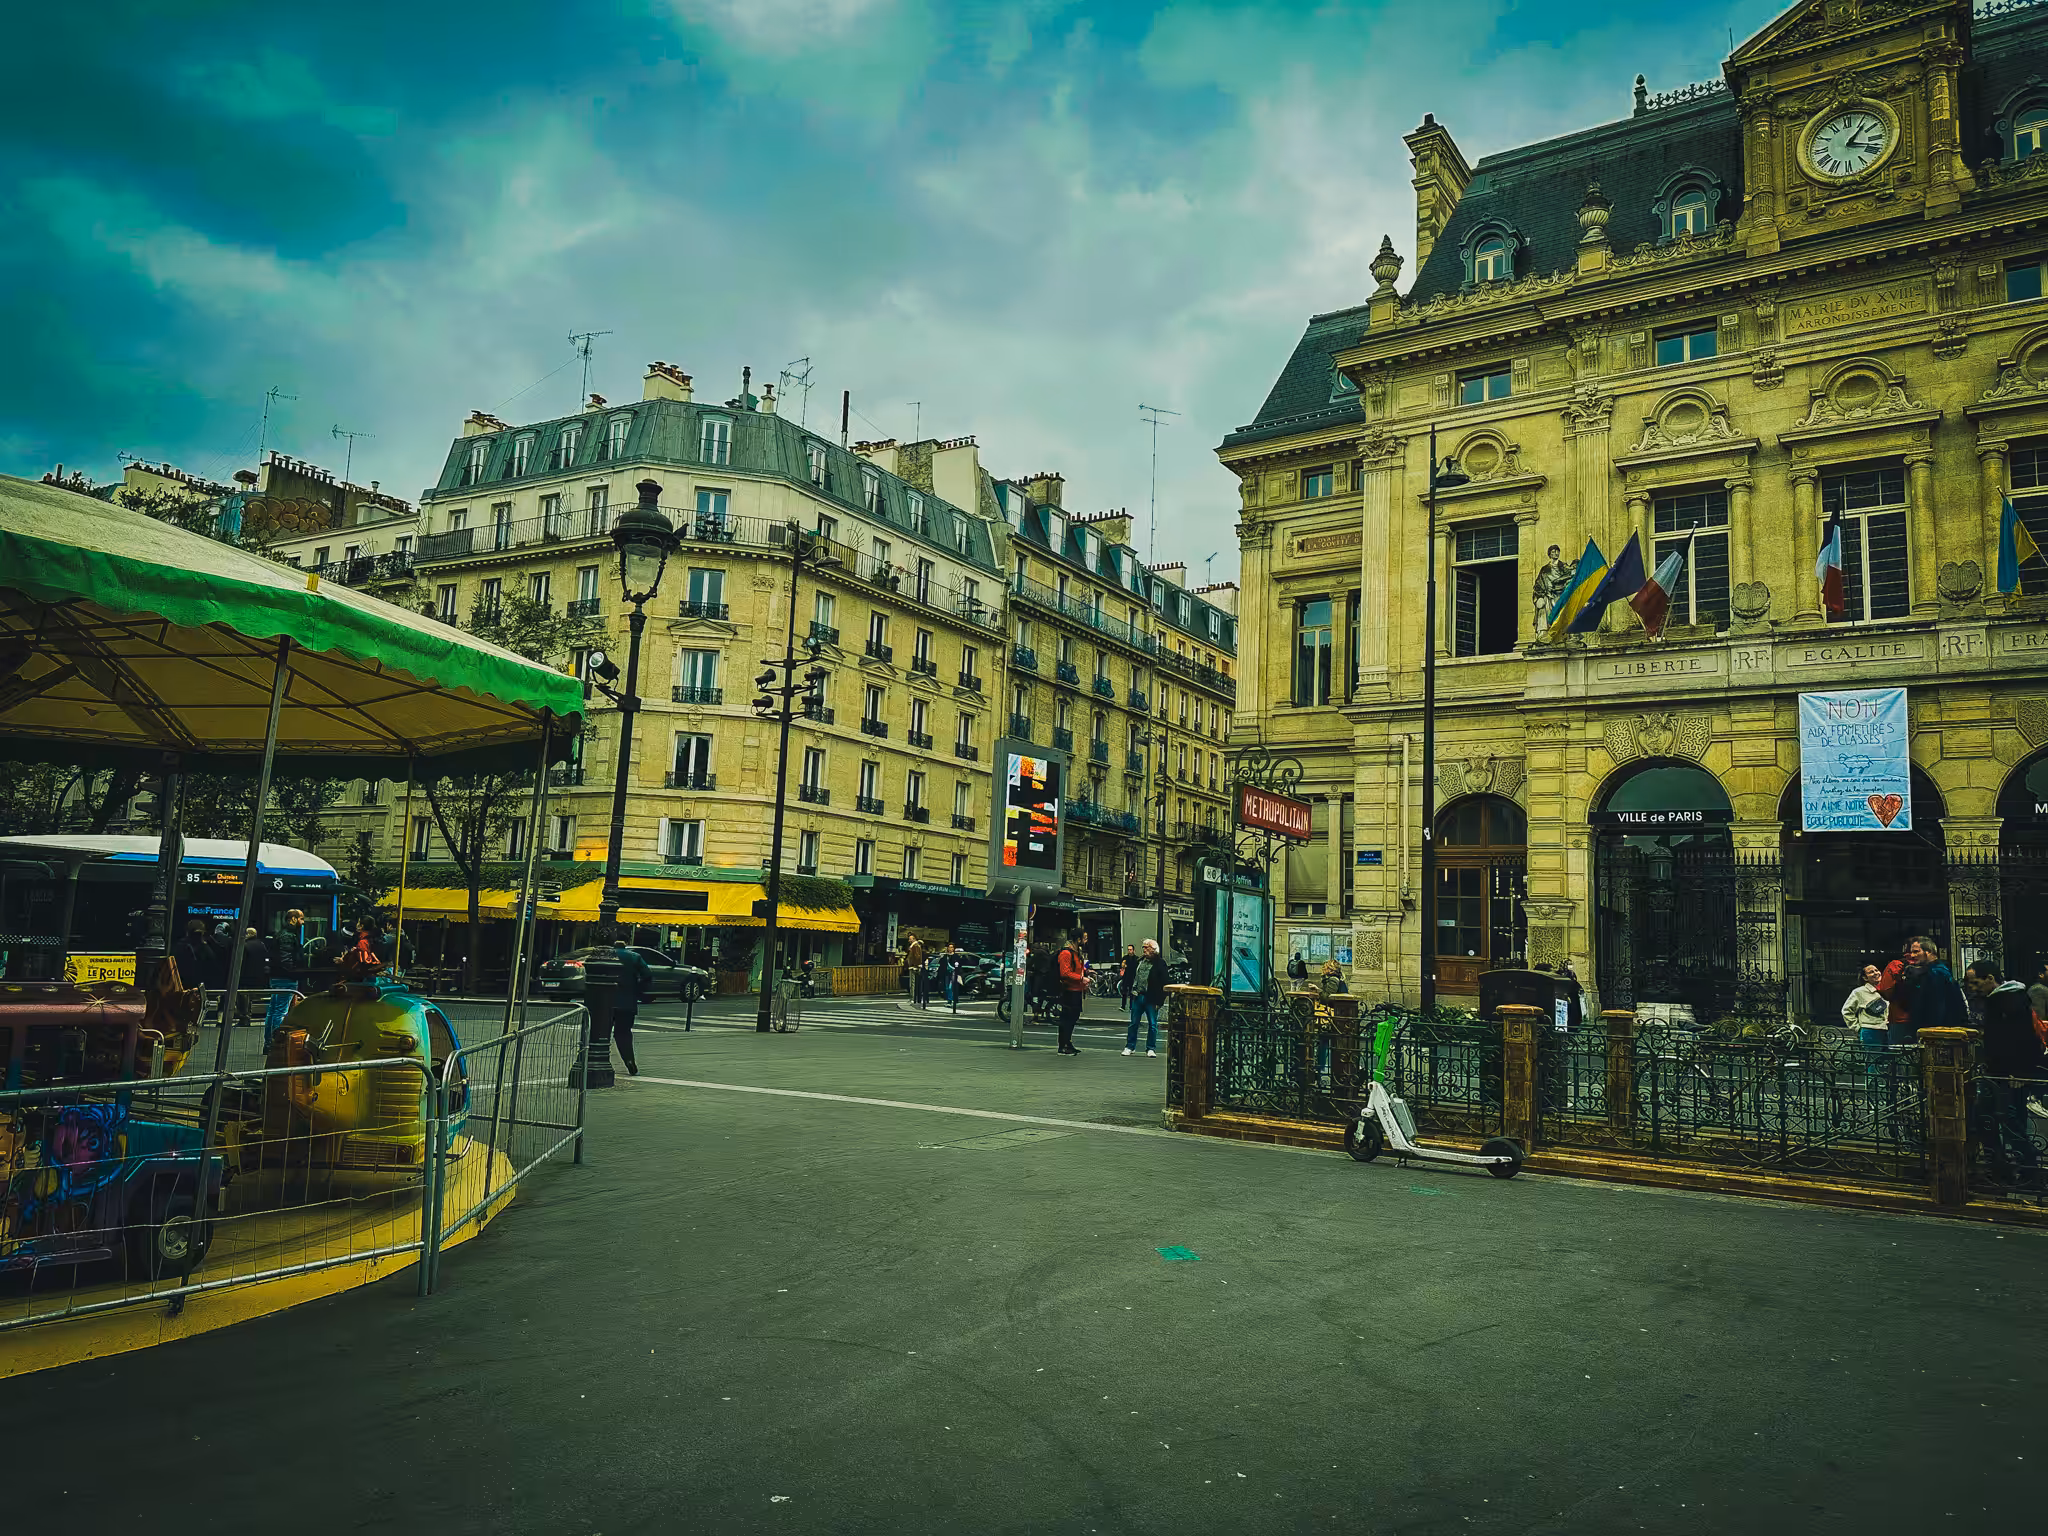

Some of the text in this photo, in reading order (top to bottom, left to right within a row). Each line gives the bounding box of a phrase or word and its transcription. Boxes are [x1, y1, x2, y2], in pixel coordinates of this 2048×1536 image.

[1789, 300, 1844, 320] MAIRIE
[1804, 643, 1907, 662] EGALITE
[1614, 658, 1702, 676] LIBERTE
[1828, 698, 1879, 720] NON
[1808, 722, 1895, 738] AUX FERMETURES
[1821, 733, 1881, 747] DE CLASSES
[1805, 799, 1868, 811] ON AIME NOTRE
[1244, 792, 1309, 833] METROPOLITAIN
[1617, 811, 1703, 823] VILLE de PARIS
[187, 873, 200, 883] 85
[1236, 874, 1252, 886] Joffrin
[899, 881, 927, 890] COMPTOIR
[88, 969, 98, 977] LE
